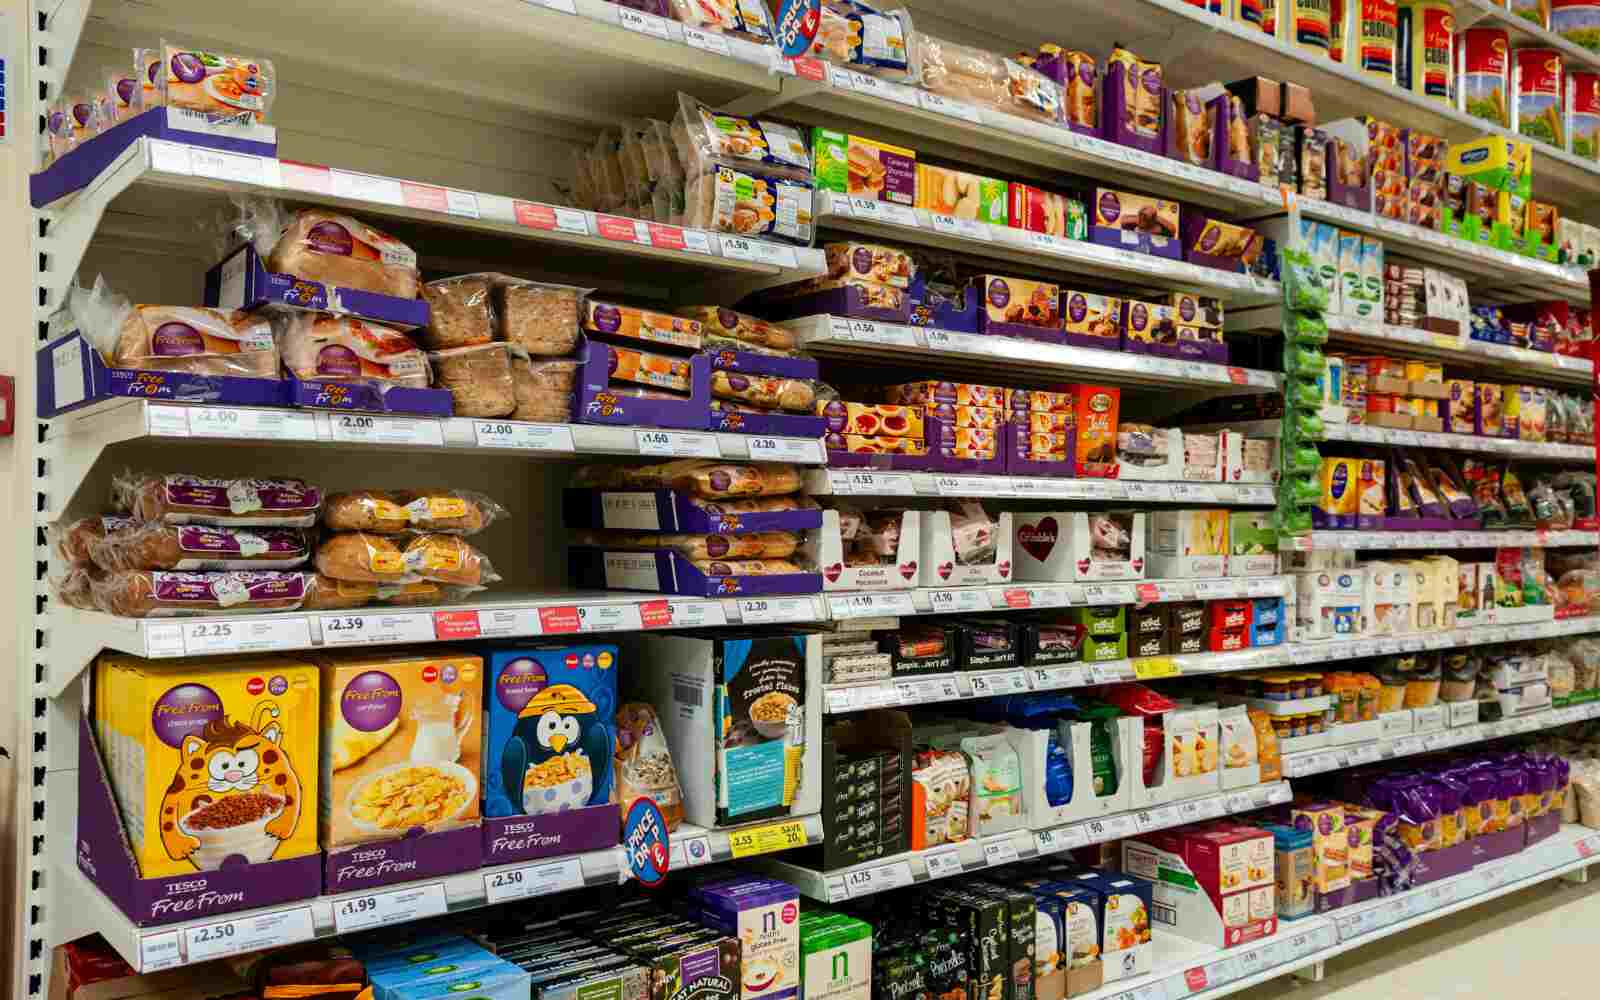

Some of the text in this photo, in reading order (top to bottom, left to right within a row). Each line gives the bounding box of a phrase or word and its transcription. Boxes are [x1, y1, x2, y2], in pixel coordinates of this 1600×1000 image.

[191, 624, 232, 638] £2.25
[327, 618, 363, 632] £2.39
[504, 822, 535, 833] TESCO
[352, 849, 386, 860] TESCO
[165, 880, 207, 892] TESCO
[491, 871, 523, 888] £2.50
[340, 897, 377, 915] £1.99
[194, 923, 235, 944] £2.50
